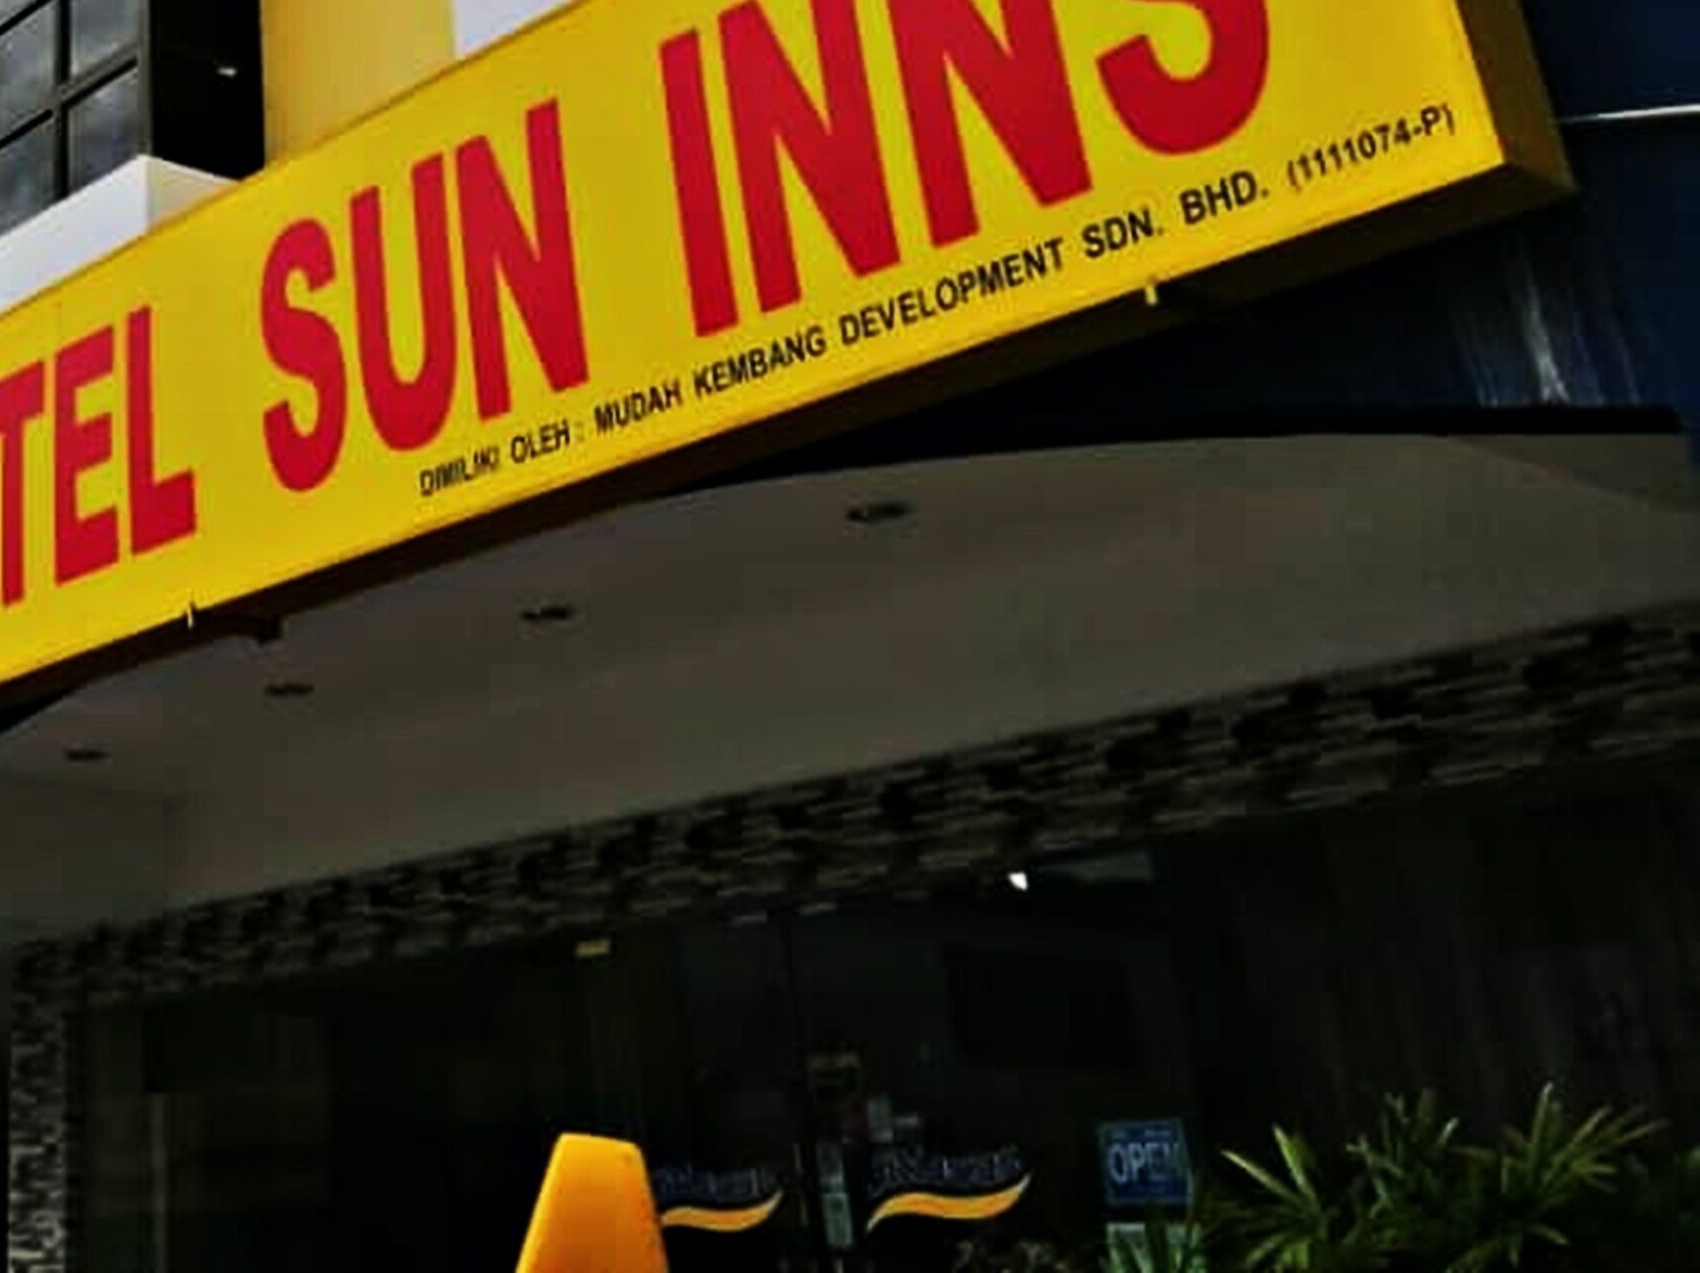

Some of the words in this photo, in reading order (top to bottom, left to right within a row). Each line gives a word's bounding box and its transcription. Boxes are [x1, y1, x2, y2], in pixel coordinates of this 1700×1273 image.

[260, 97, 590, 493] SUN
[510, 418, 571, 465] OLEH
[593, 379, 684, 434] MUDAH
[693, 326, 828, 396] KEMBANG
[840, 237, 1065, 348] DEVELOPMENT
[1081, 210, 1164, 260] SDN.
[1179, 169, 1270, 227] BHD.
[1285, 102, 1456, 195] (1111074-P)
